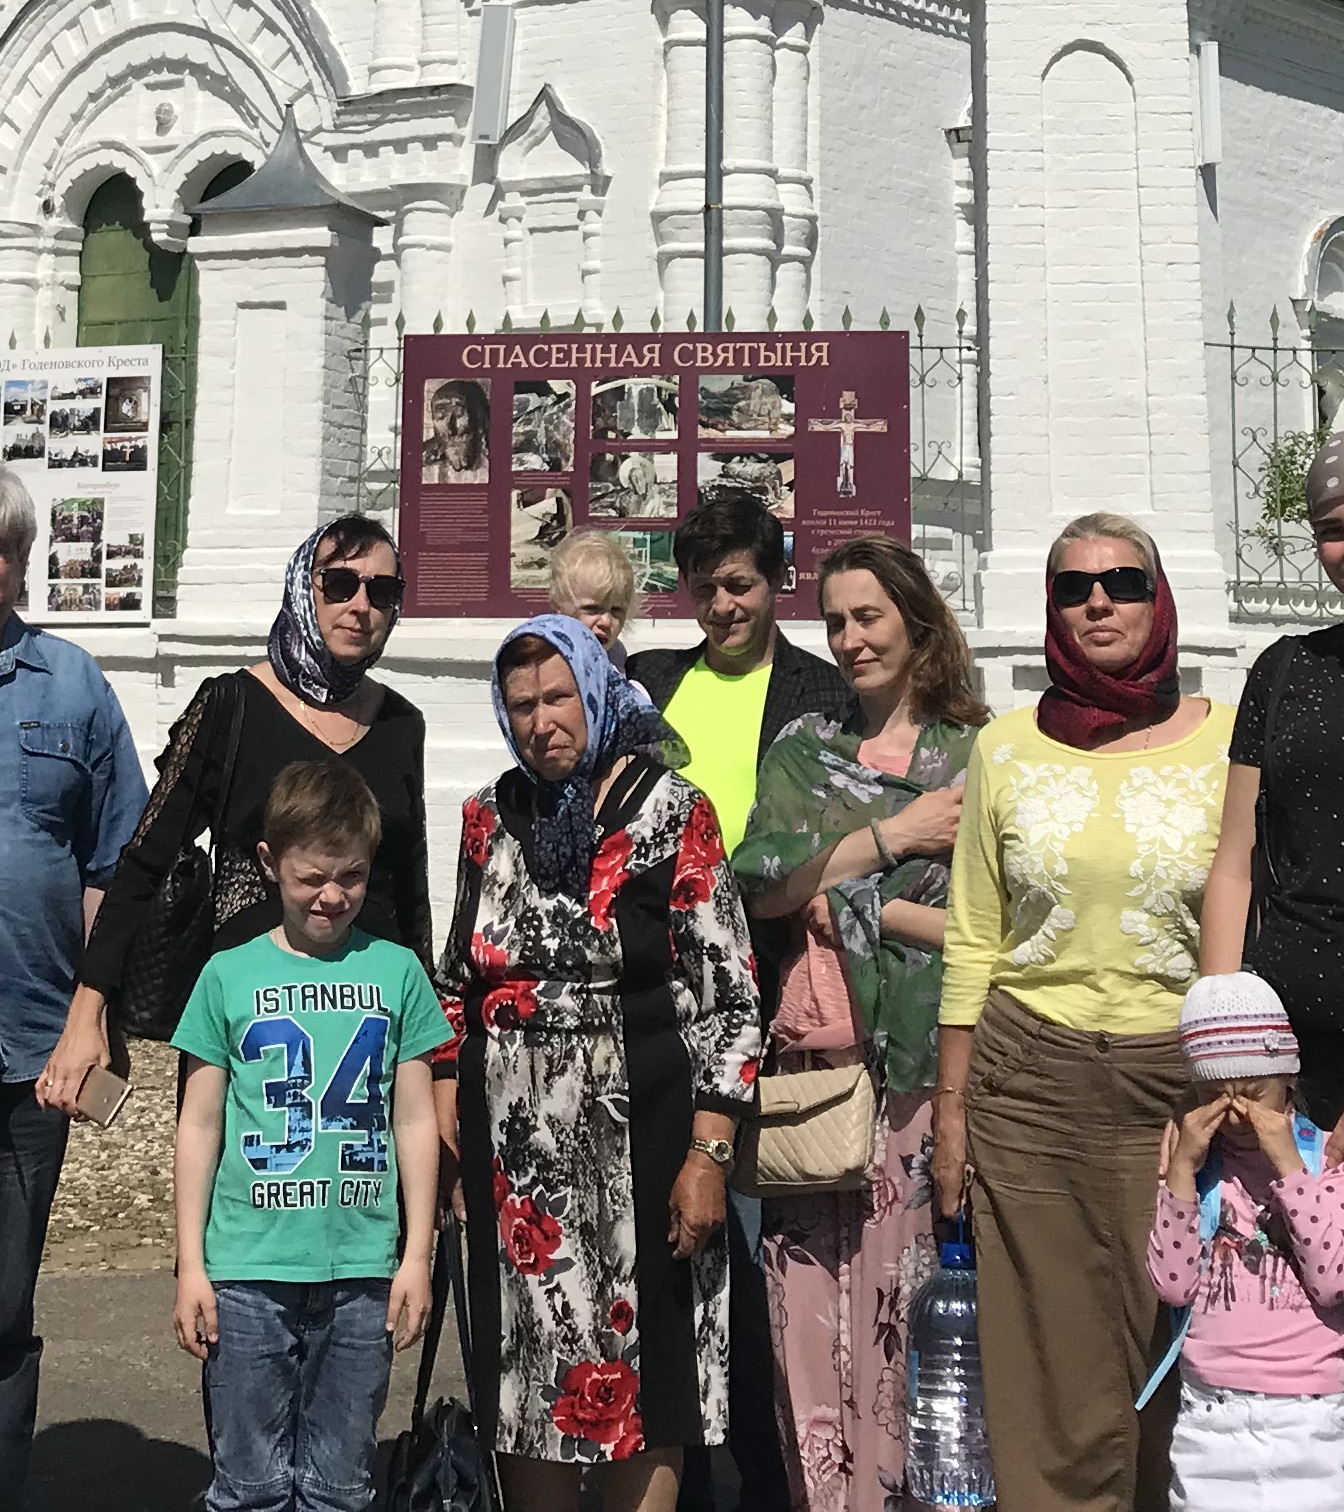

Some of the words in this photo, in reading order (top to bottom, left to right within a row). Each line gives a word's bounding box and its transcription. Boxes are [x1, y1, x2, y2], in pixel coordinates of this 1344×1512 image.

[21, 358, 105, 371] Годеновского
[107, 355, 150, 370] Креста
[461, 343, 662, 369] СПАСЕННАЯ
[672, 341, 830, 368] СВЯТЫНЯ
[254, 983, 391, 1016] ISTANBUL
[238, 1014, 392, 1175] 34
[250, 1178, 333, 1210] GREAT
[338, 1177, 384, 1209] CITY
